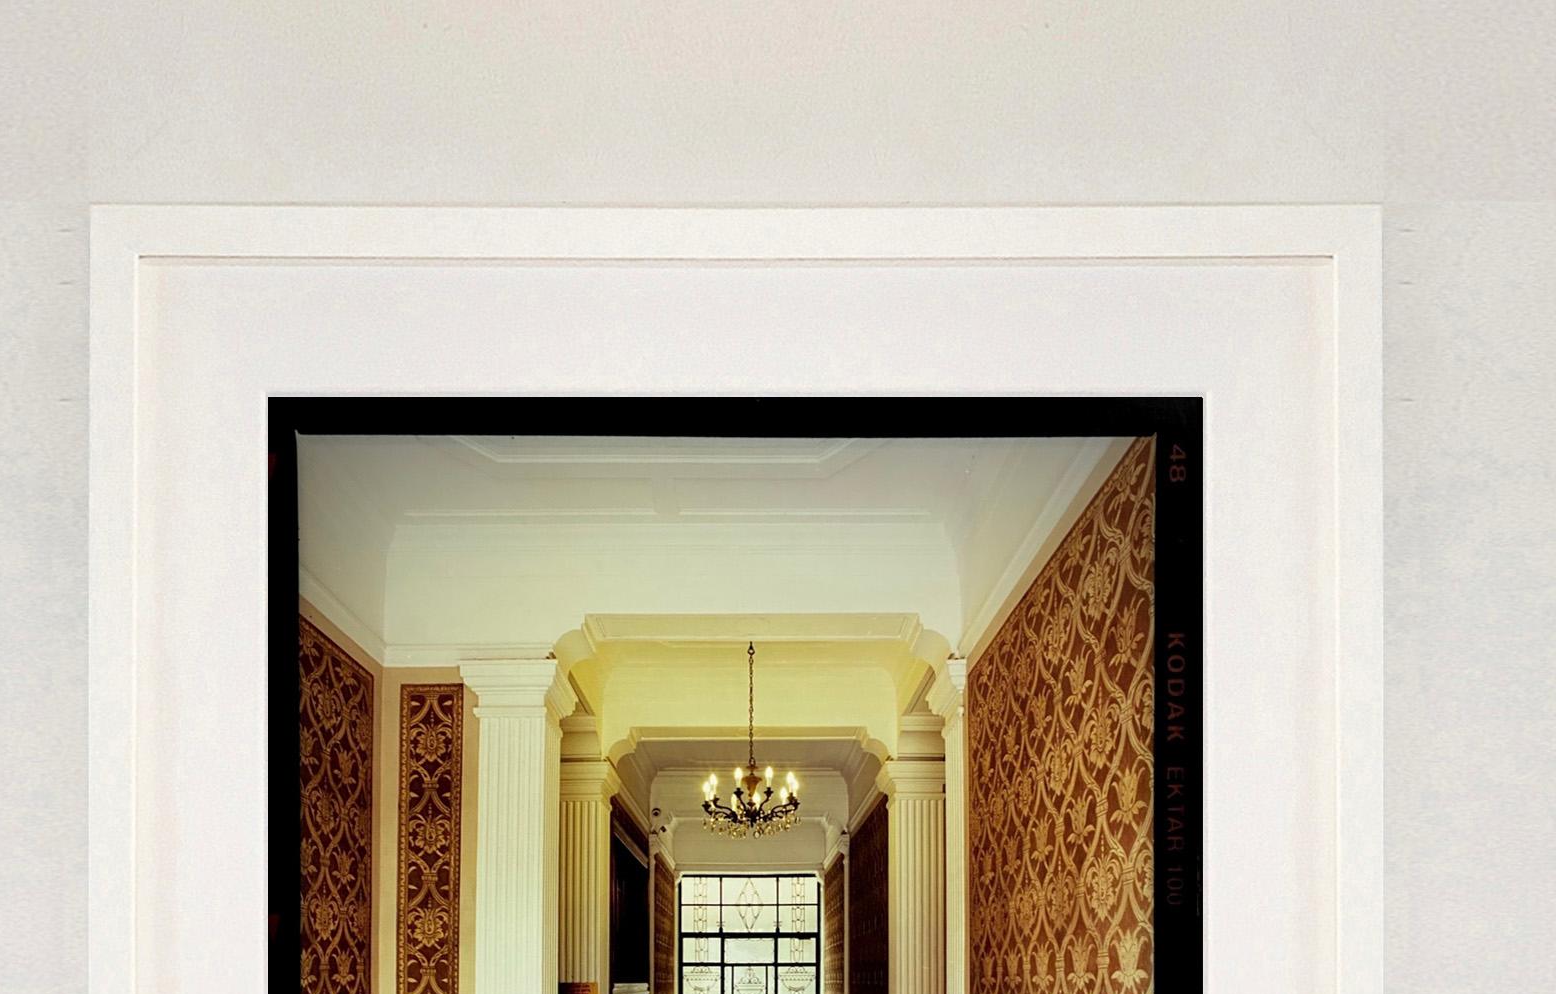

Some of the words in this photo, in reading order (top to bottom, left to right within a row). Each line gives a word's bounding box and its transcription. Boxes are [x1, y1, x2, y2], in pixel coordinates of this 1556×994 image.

[1168, 442, 1188, 483] 48
[1166, 632, 1187, 742] KODAK
[1166, 766, 1186, 851] EKTAR
